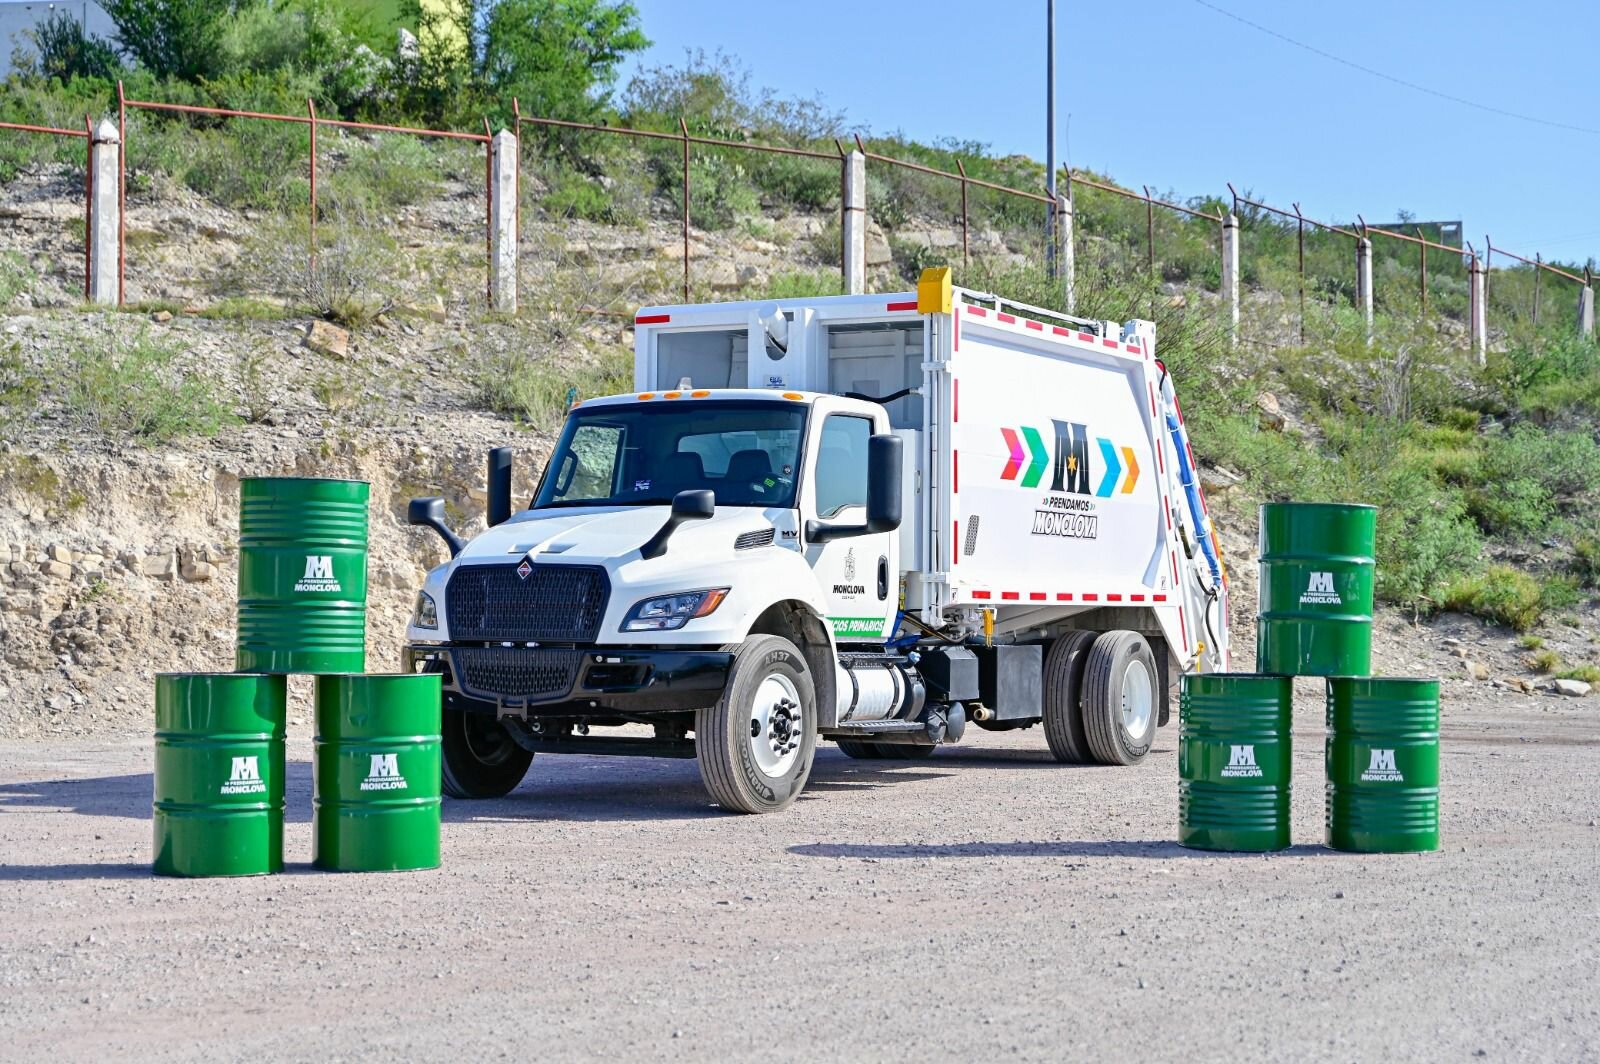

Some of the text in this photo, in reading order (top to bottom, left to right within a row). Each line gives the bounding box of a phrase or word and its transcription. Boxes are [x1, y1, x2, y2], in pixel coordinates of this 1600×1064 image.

[1049, 497, 1090, 512] PRENDAMOS
[1031, 510, 1098, 540] MONCLOVA
[294, 583, 341, 592] MONCLOVA
[832, 585, 865, 595] MONCLOVA
[1299, 596, 1341, 604] MONCLOVA
[848, 620, 884, 632] PRIMARIOS
[1221, 769, 1263, 777] MONCLOVA
[1361, 773, 1404, 782] MONCLOVA
[220, 784, 266, 794] MONCLOVA
[360, 781, 408, 791] MONCLOVA
